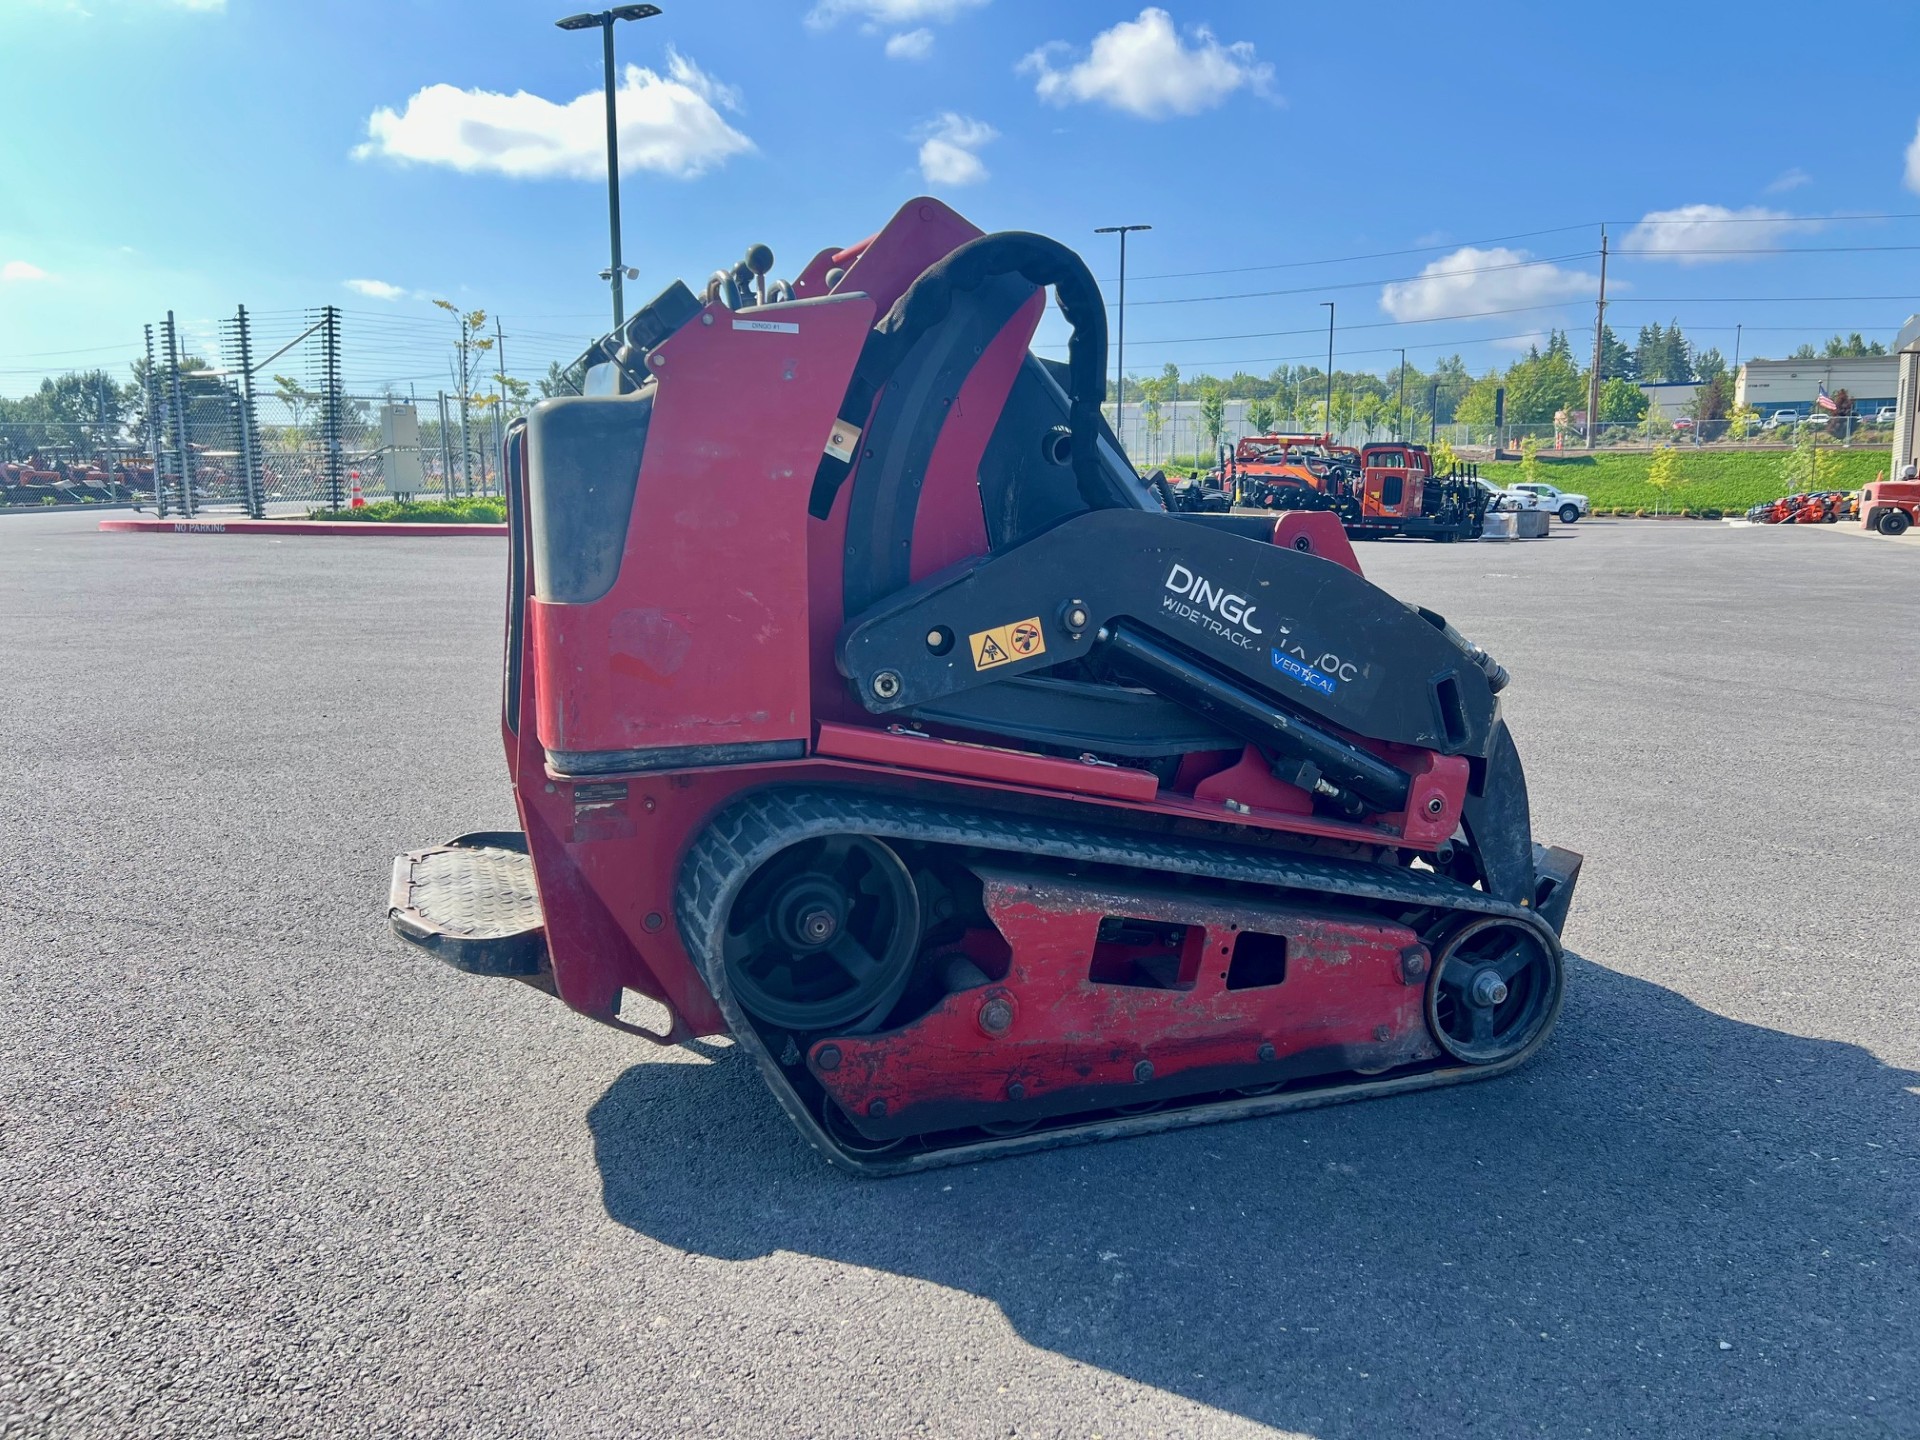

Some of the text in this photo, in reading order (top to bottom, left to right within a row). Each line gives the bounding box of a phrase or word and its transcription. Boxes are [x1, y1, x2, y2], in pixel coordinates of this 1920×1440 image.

[773, 323, 780, 331] #1
[174, 523, 226, 533] NO PARKING
[1274, 653, 1334, 693] VERTICAL
